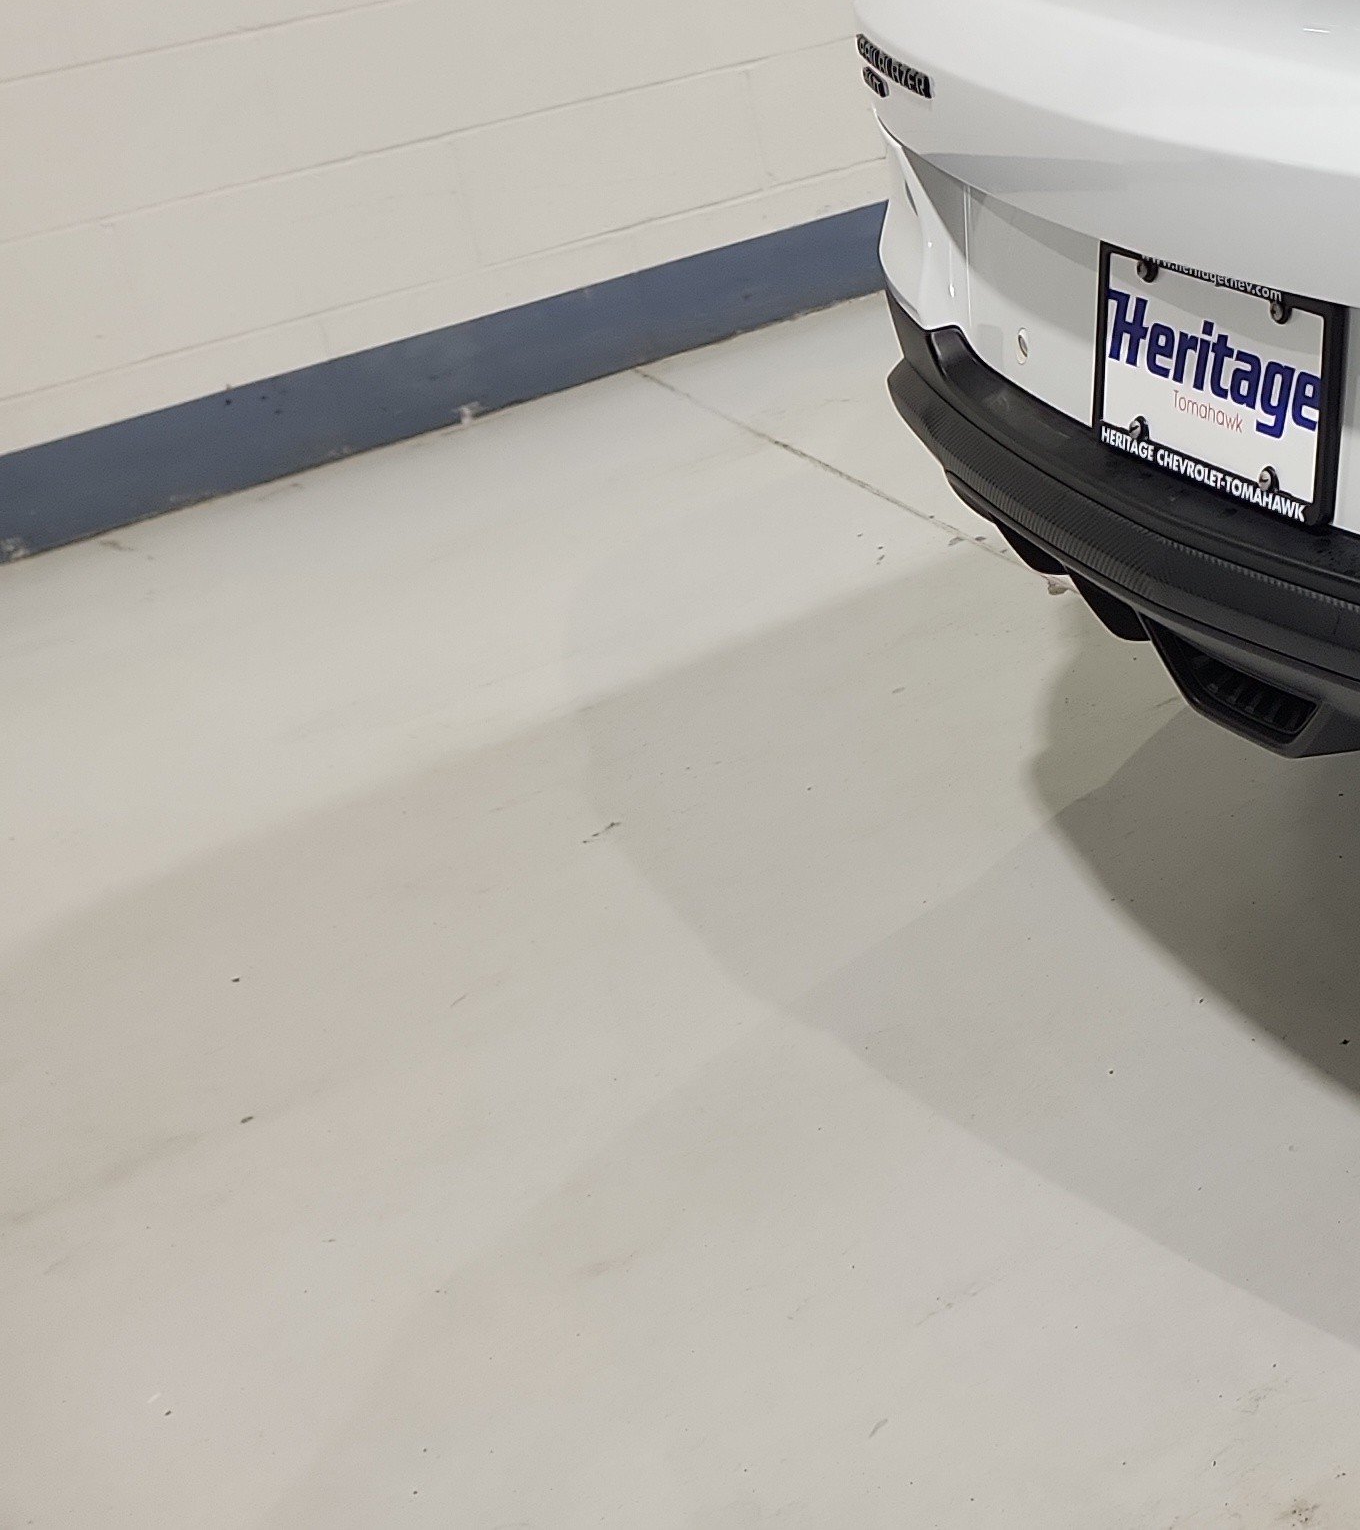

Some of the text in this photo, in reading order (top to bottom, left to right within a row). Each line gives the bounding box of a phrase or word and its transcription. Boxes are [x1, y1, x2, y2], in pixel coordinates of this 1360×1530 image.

[1106, 288, 1321, 439] Heritage
[1173, 389, 1243, 434] Tomahawk
[1101, 426, 1306, 523] HERITAGE CHEVROLET-TOMAHAWK
